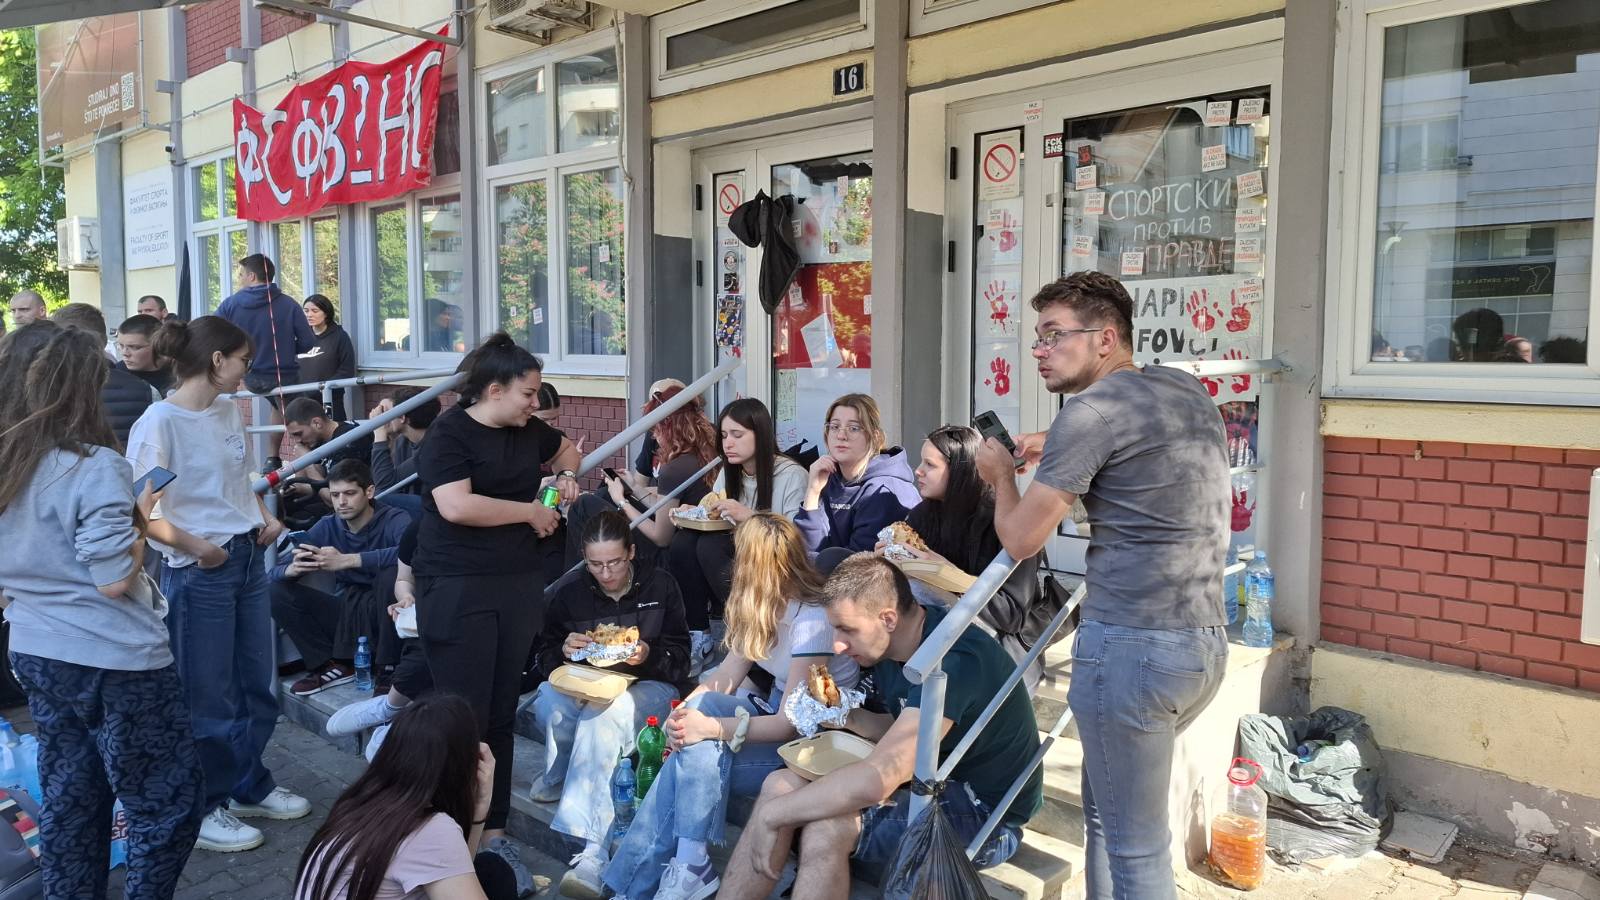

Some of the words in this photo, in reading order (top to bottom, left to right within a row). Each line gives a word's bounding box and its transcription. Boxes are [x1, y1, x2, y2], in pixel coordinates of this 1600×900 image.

[839, 66, 858, 92] 16
[1045, 136, 1063, 147] FCK
[1045, 144, 1063, 154] SNS
[1108, 177, 1232, 221] СПОРТСКИ
[1133, 215, 1212, 241] ПРОТИВ
